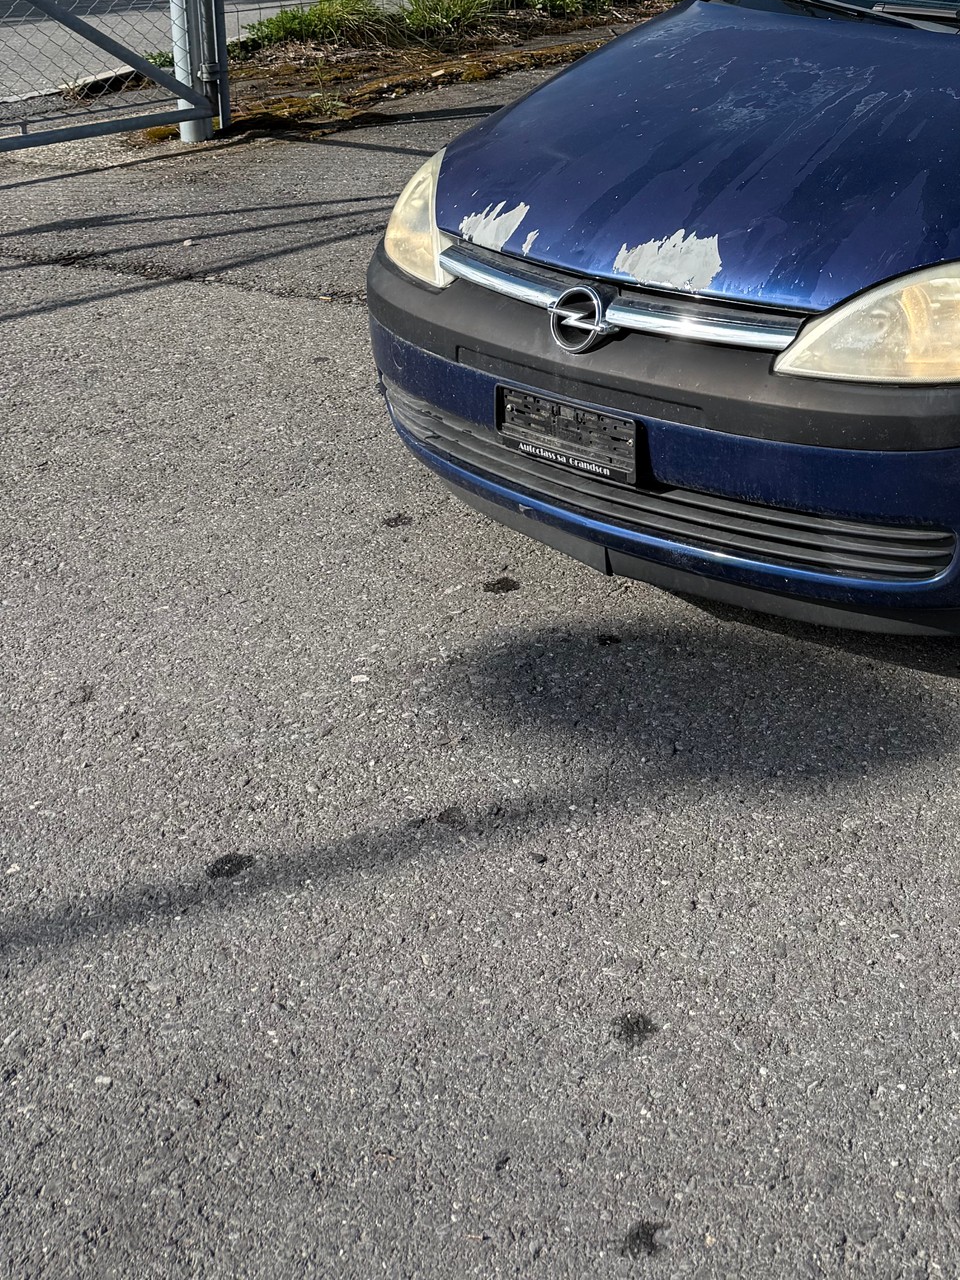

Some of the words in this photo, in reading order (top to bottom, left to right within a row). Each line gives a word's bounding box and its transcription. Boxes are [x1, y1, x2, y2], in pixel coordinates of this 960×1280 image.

[518, 442, 556, 460] Autoclass
[557, 453, 567, 463] sa
[569, 457, 610, 476] Grandson
